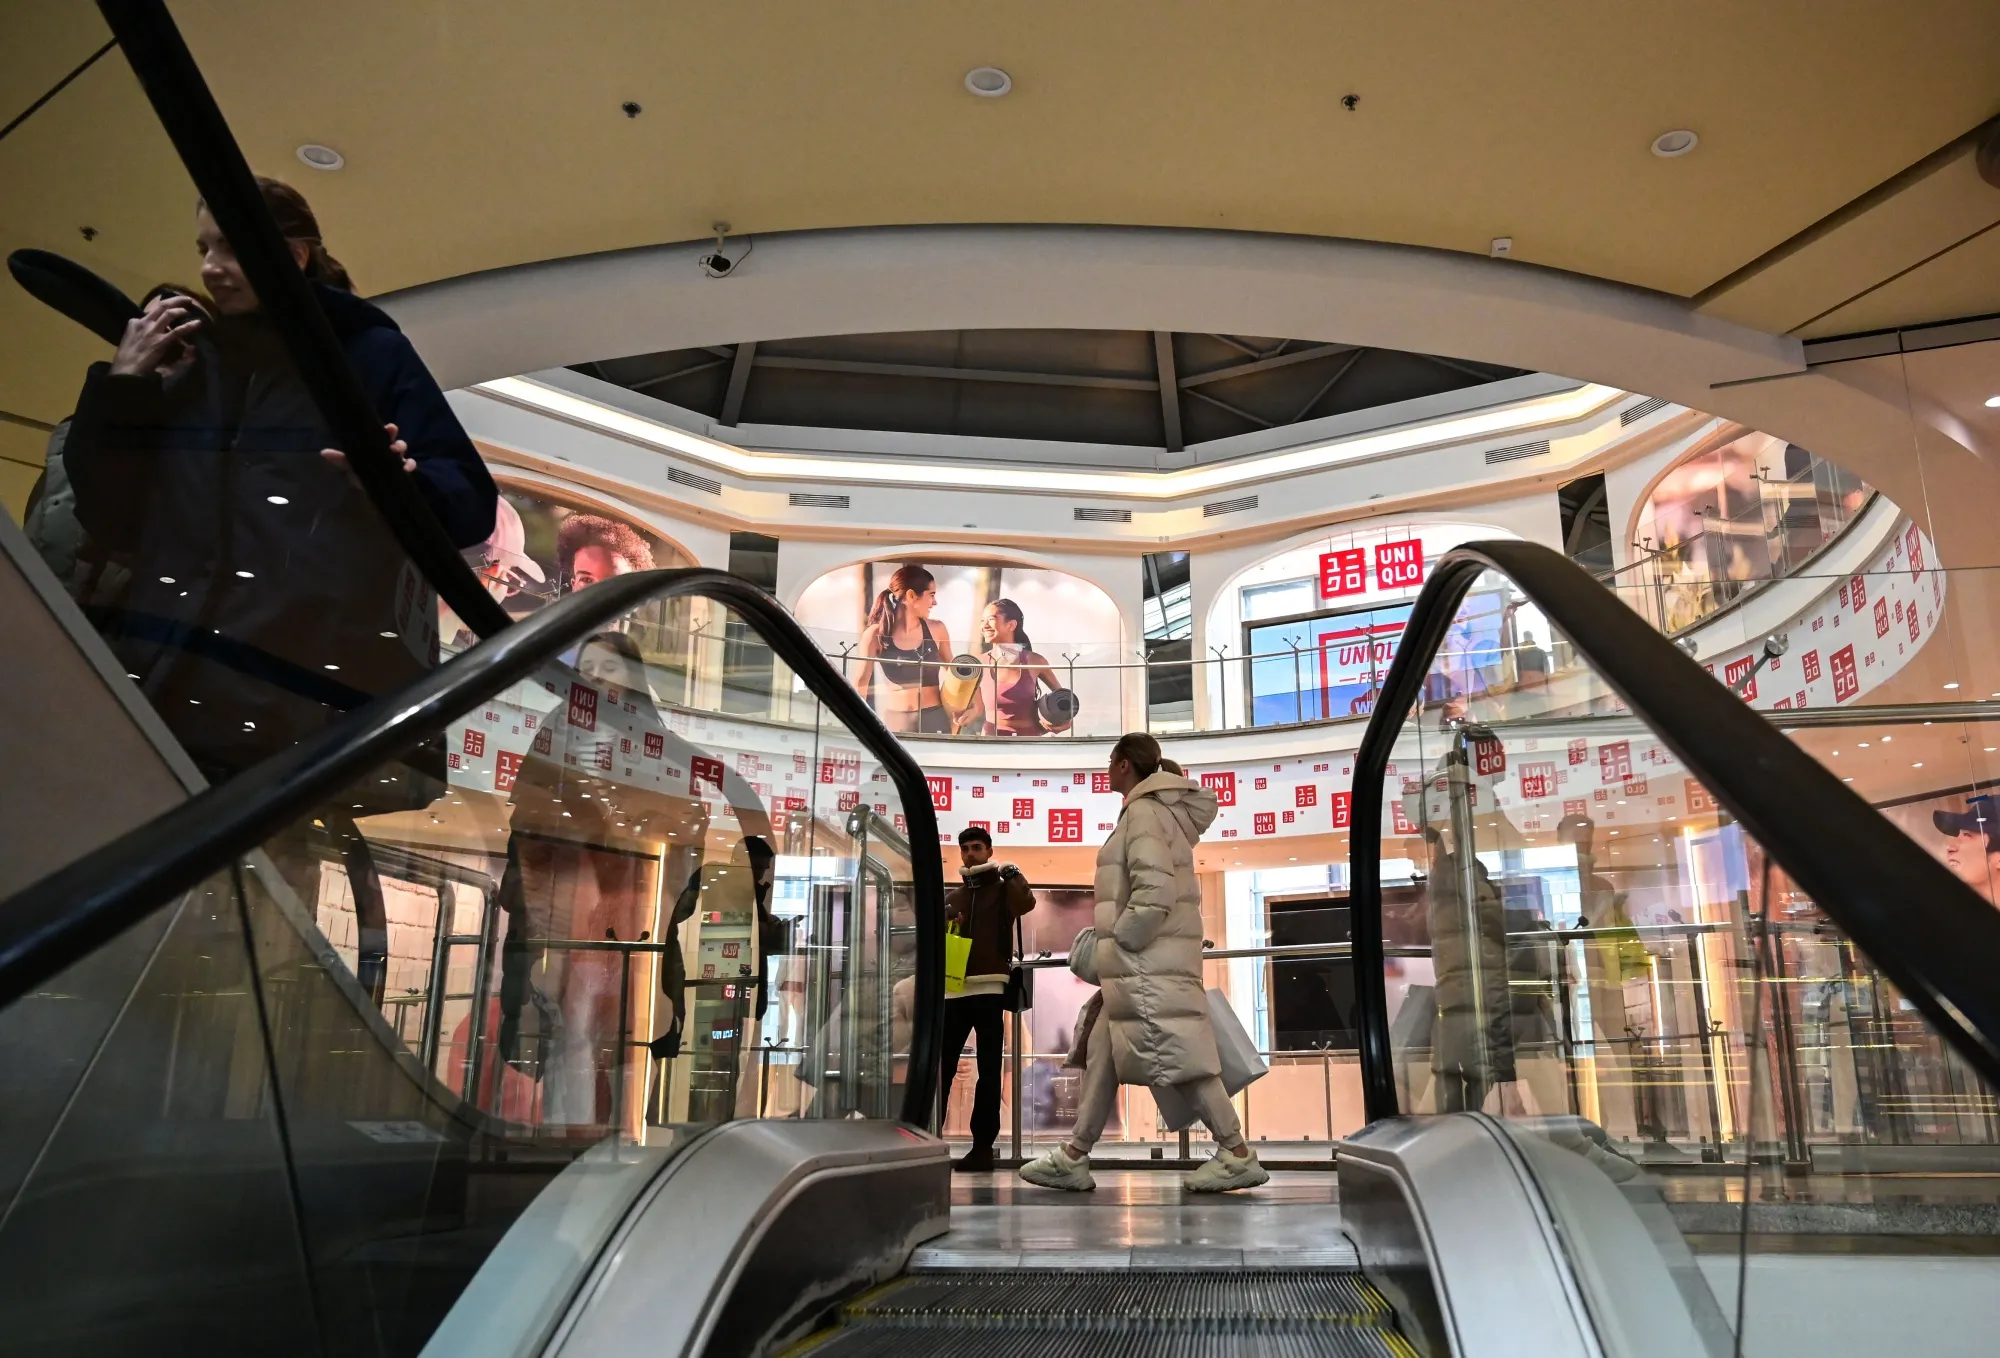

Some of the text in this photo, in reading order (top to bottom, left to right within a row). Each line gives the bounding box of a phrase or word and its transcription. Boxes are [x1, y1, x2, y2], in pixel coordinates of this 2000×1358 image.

[1380, 545, 1414, 565] UNI
[1327, 554, 1360, 573] ユニ
[1381, 563, 1418, 585] QLO
[1327, 573, 1361, 592] クロ
[1875, 602, 1885, 620] UNI
[1877, 619, 1888, 635] QLO
[1834, 651, 1852, 675] ユニ
[1728, 662, 1751, 684] UNI
[1837, 672, 1856, 696] クロ
[465, 733, 482, 744] ユニ
[465, 743, 481, 754] クロ
[1204, 777, 1229, 791] UNI
[1298, 787, 1314, 796] ユニ
[931, 796, 948, 807] LO
[1015, 800, 1031, 809] ユニ
[1298, 796, 1315, 805] クロ
[1014, 809, 1031, 817] クロ
[1052, 812, 1078, 825] ユニ
[1256, 815, 1272, 824] UNI
[1051, 827, 1078, 839] クロ
[1256, 823, 1274, 833] QLO
